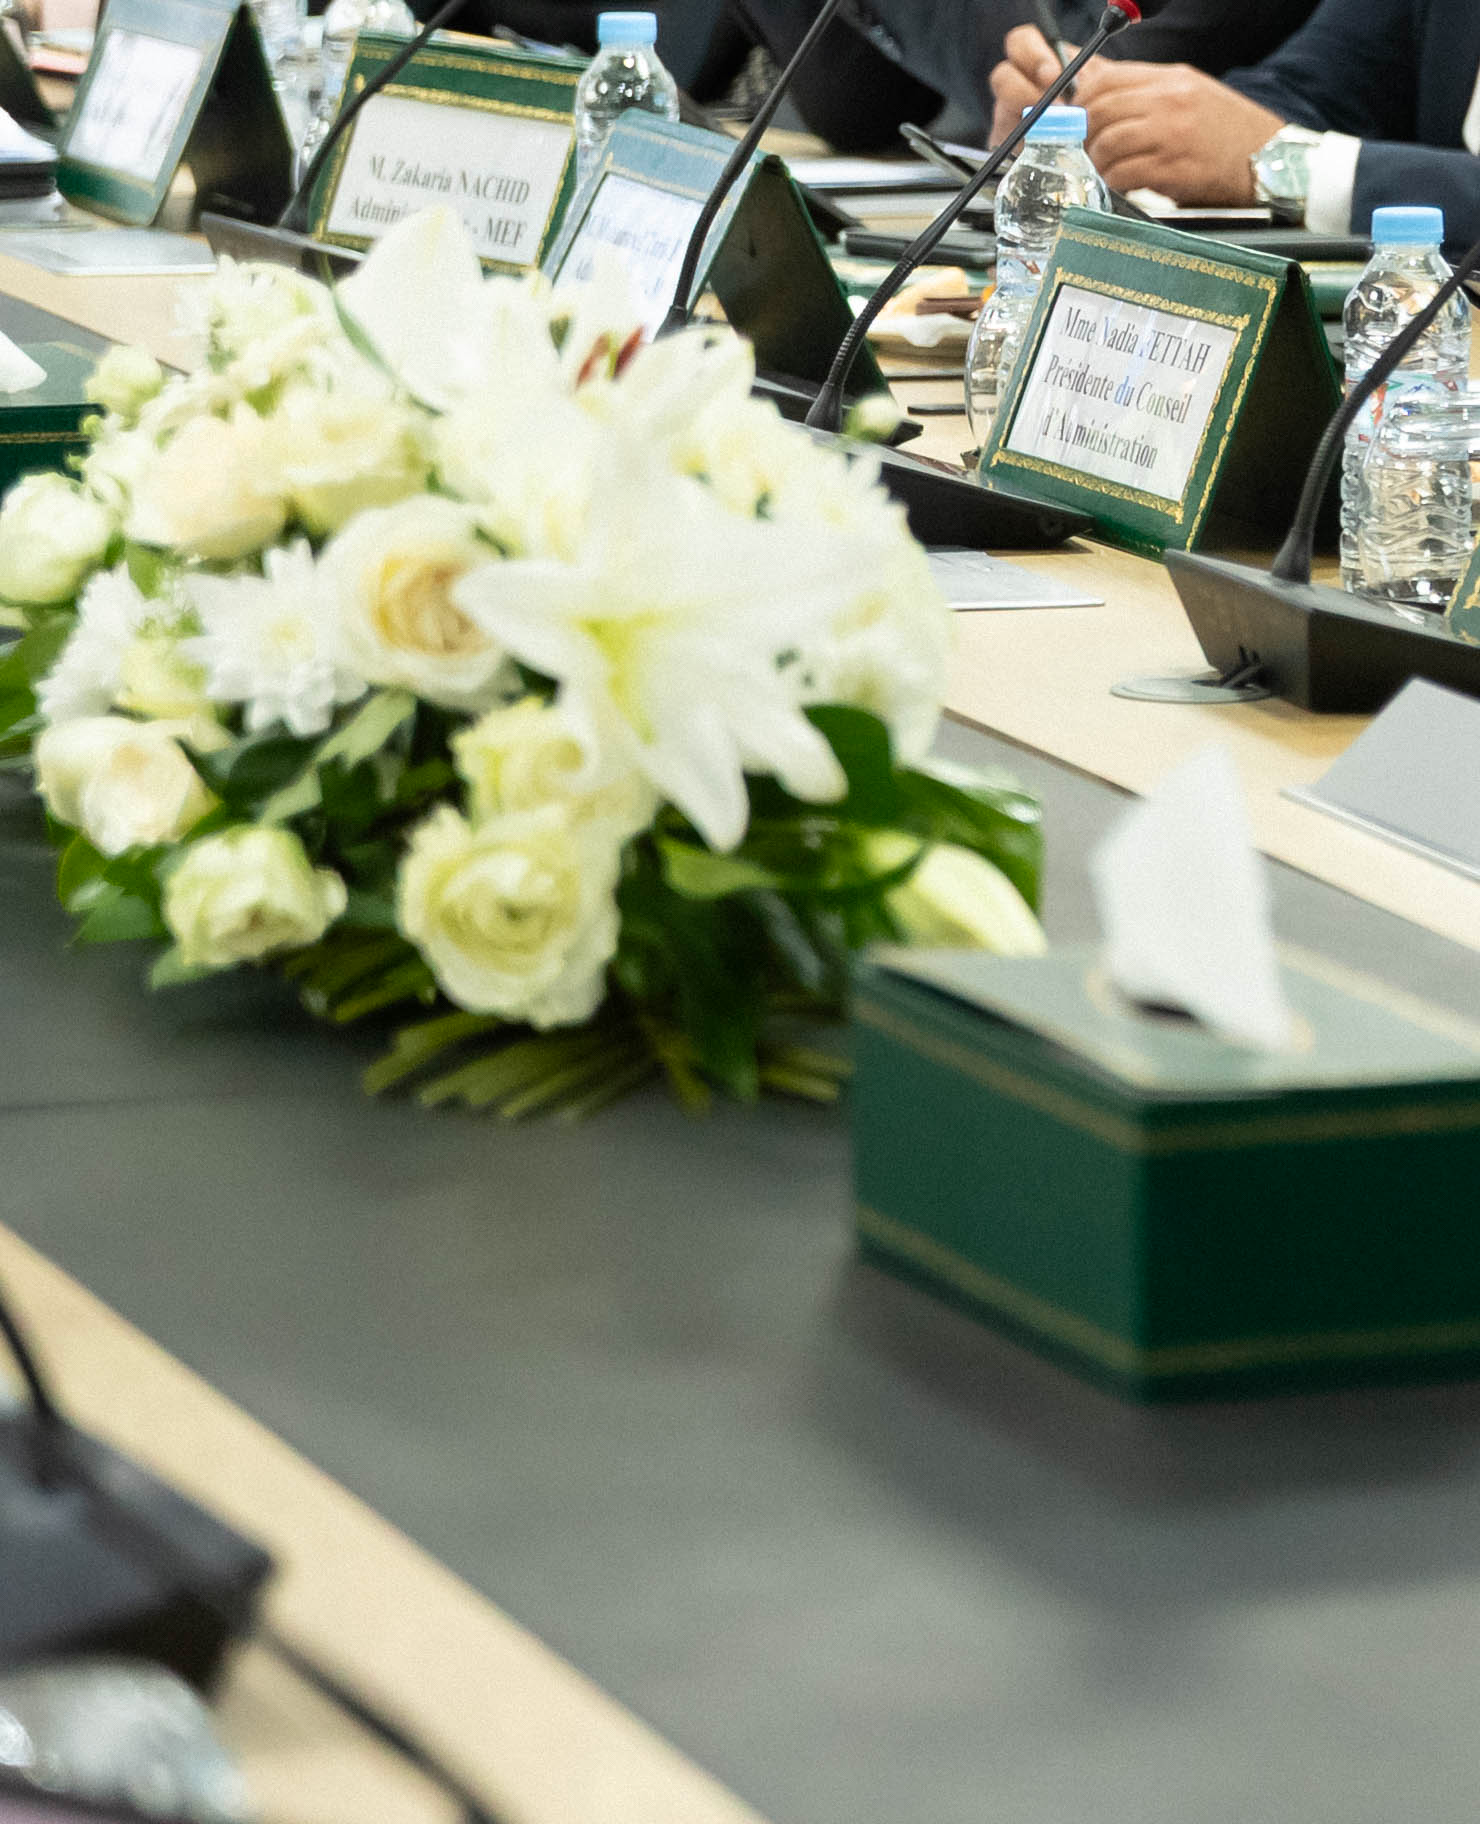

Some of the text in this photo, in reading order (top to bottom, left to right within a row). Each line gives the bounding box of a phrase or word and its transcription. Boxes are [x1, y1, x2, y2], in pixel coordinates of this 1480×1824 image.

[369, 155, 531, 206] M. Zakaria NACHID
[483, 216, 528, 249] MEF
[1060, 306, 1097, 344] Mme
[1096, 316, 1139, 356] Nadia
[1043, 353, 1195, 426] Présidente du Conseil
